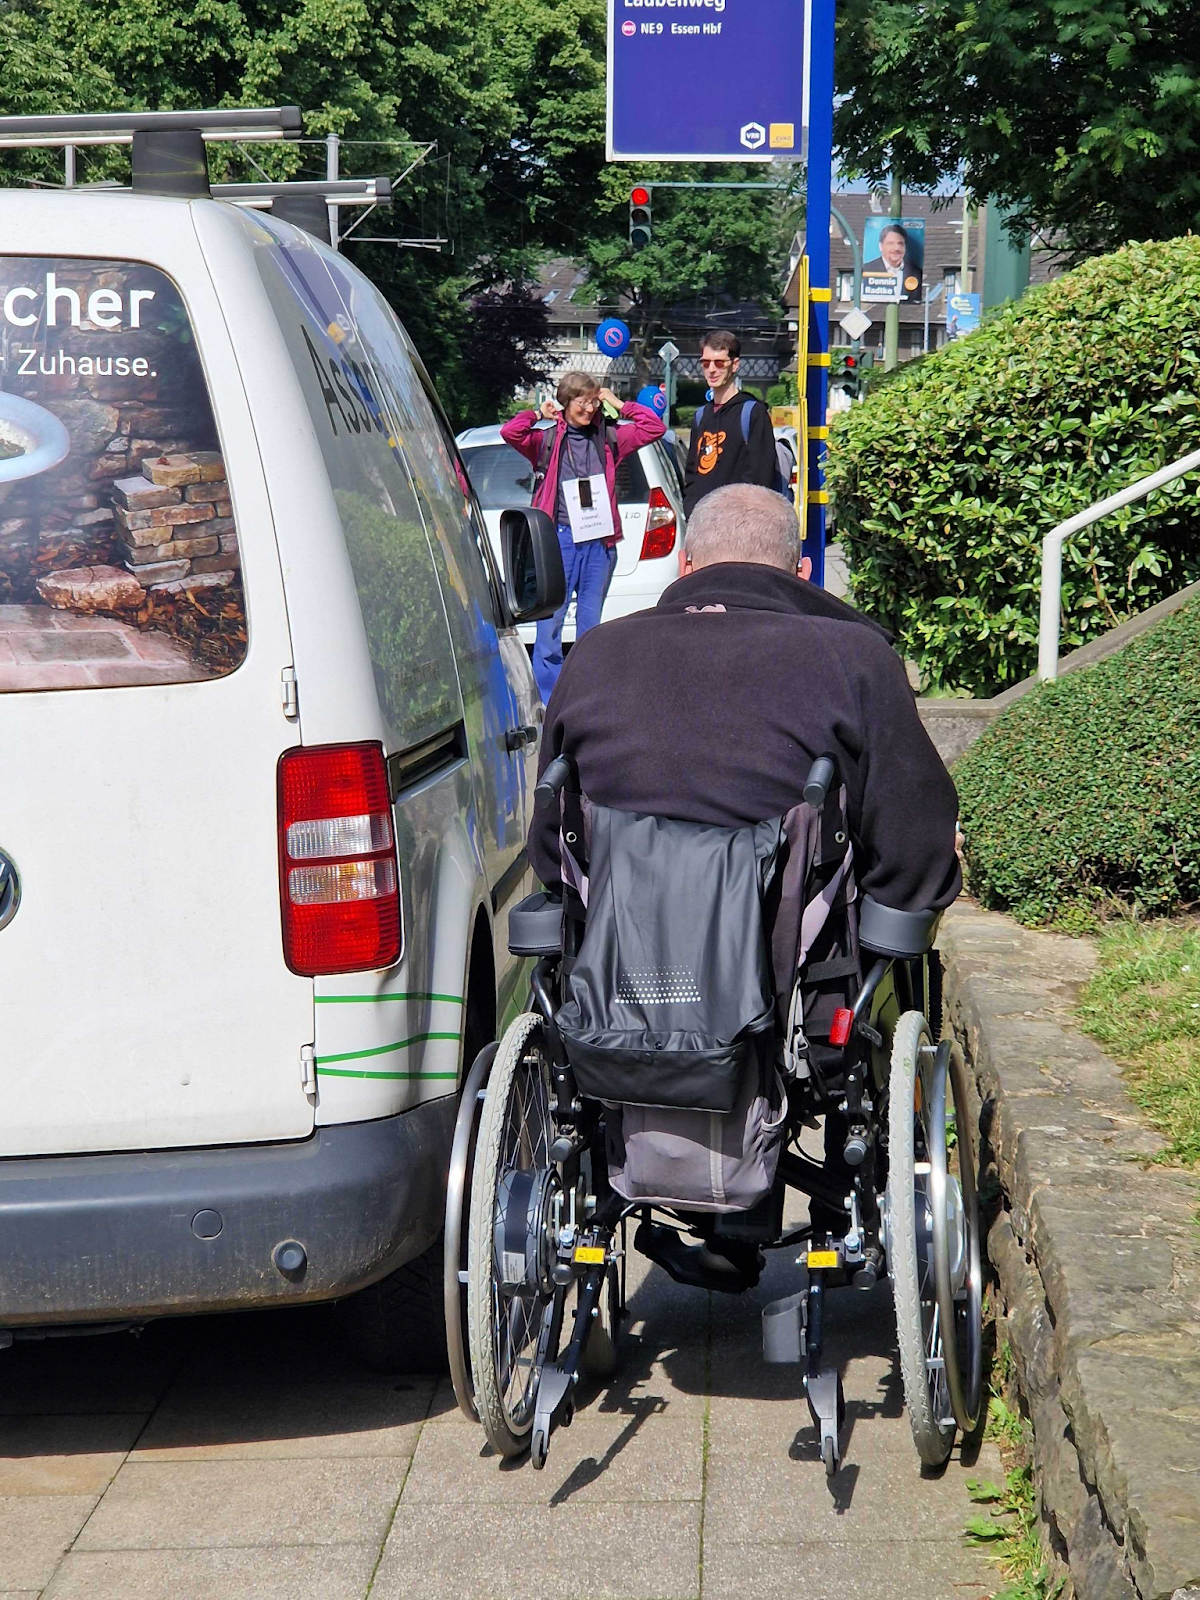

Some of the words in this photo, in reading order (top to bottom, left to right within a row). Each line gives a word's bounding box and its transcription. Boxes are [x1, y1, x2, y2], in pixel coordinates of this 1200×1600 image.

[640, 22, 664, 34] NE9
[671, 22, 700, 34] Essen
[702, 22, 722, 34] Hbf
[868, 277, 897, 286] Dennis
[3, 272, 156, 328] cher
[17, 349, 157, 377] Zuhause.
